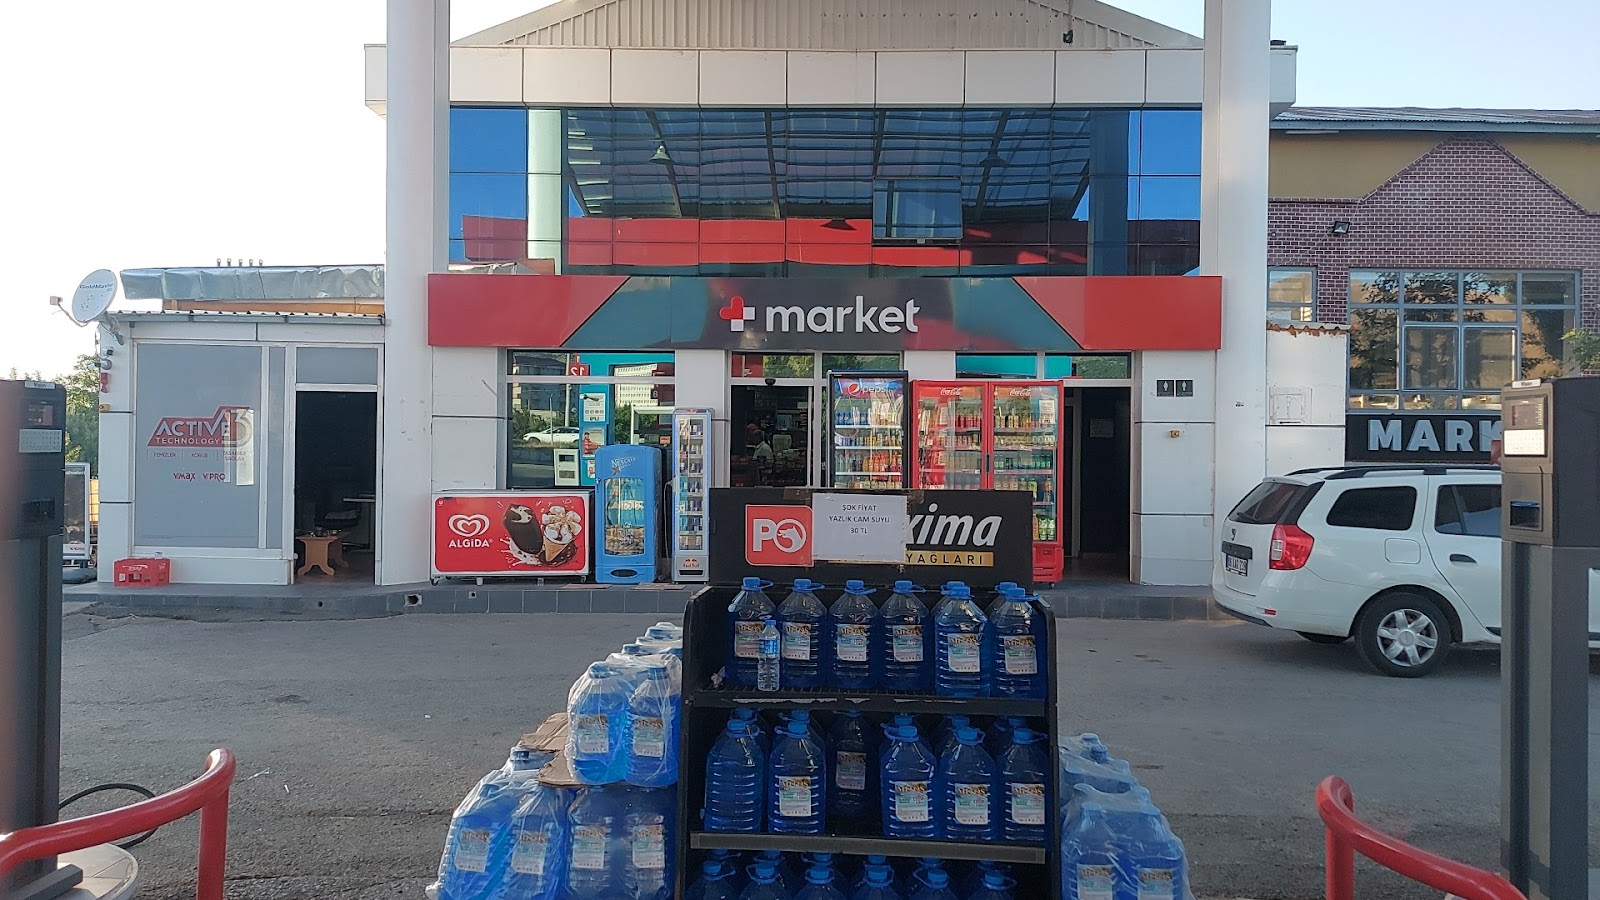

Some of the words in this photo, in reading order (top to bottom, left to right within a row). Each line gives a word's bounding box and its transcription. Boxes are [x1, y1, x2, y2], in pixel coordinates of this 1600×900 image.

[765, 295, 921, 333] market
[155, 437, 220, 445] TECHNOLOGY
[842, 504, 857, 512] ŞOK
[858, 503, 877, 511] FİYAT
[828, 515, 853, 523] YAZLIK
[853, 515, 870, 523] CAM
[905, 551, 982, 564] YAĞLARI
